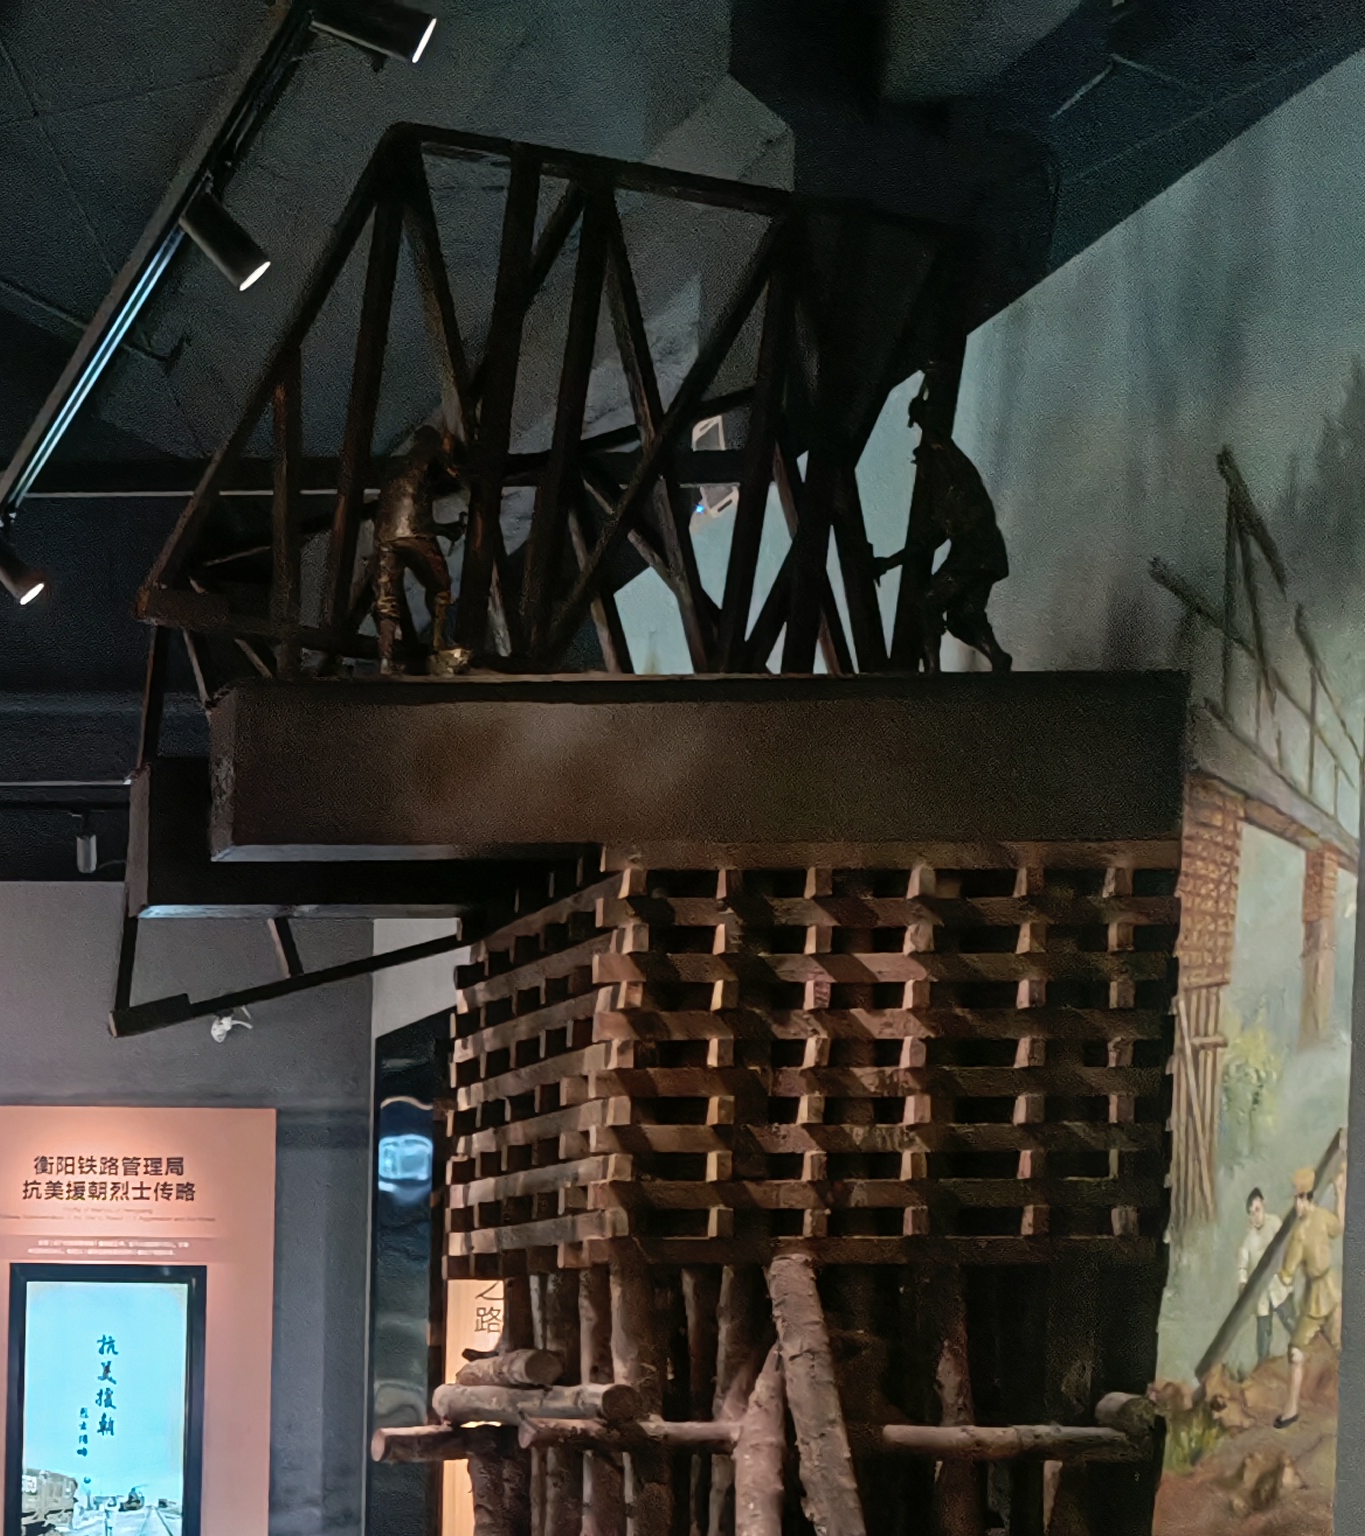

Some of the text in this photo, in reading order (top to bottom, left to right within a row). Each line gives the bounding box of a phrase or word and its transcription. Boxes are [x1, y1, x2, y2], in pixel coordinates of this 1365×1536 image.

[33, 1155, 185, 1176] 衡阳铁路管理局
[22, 1180, 196, 1202] 抗美援朝烈士传略
[95, 1334, 119, 1437] 抗美援朝
